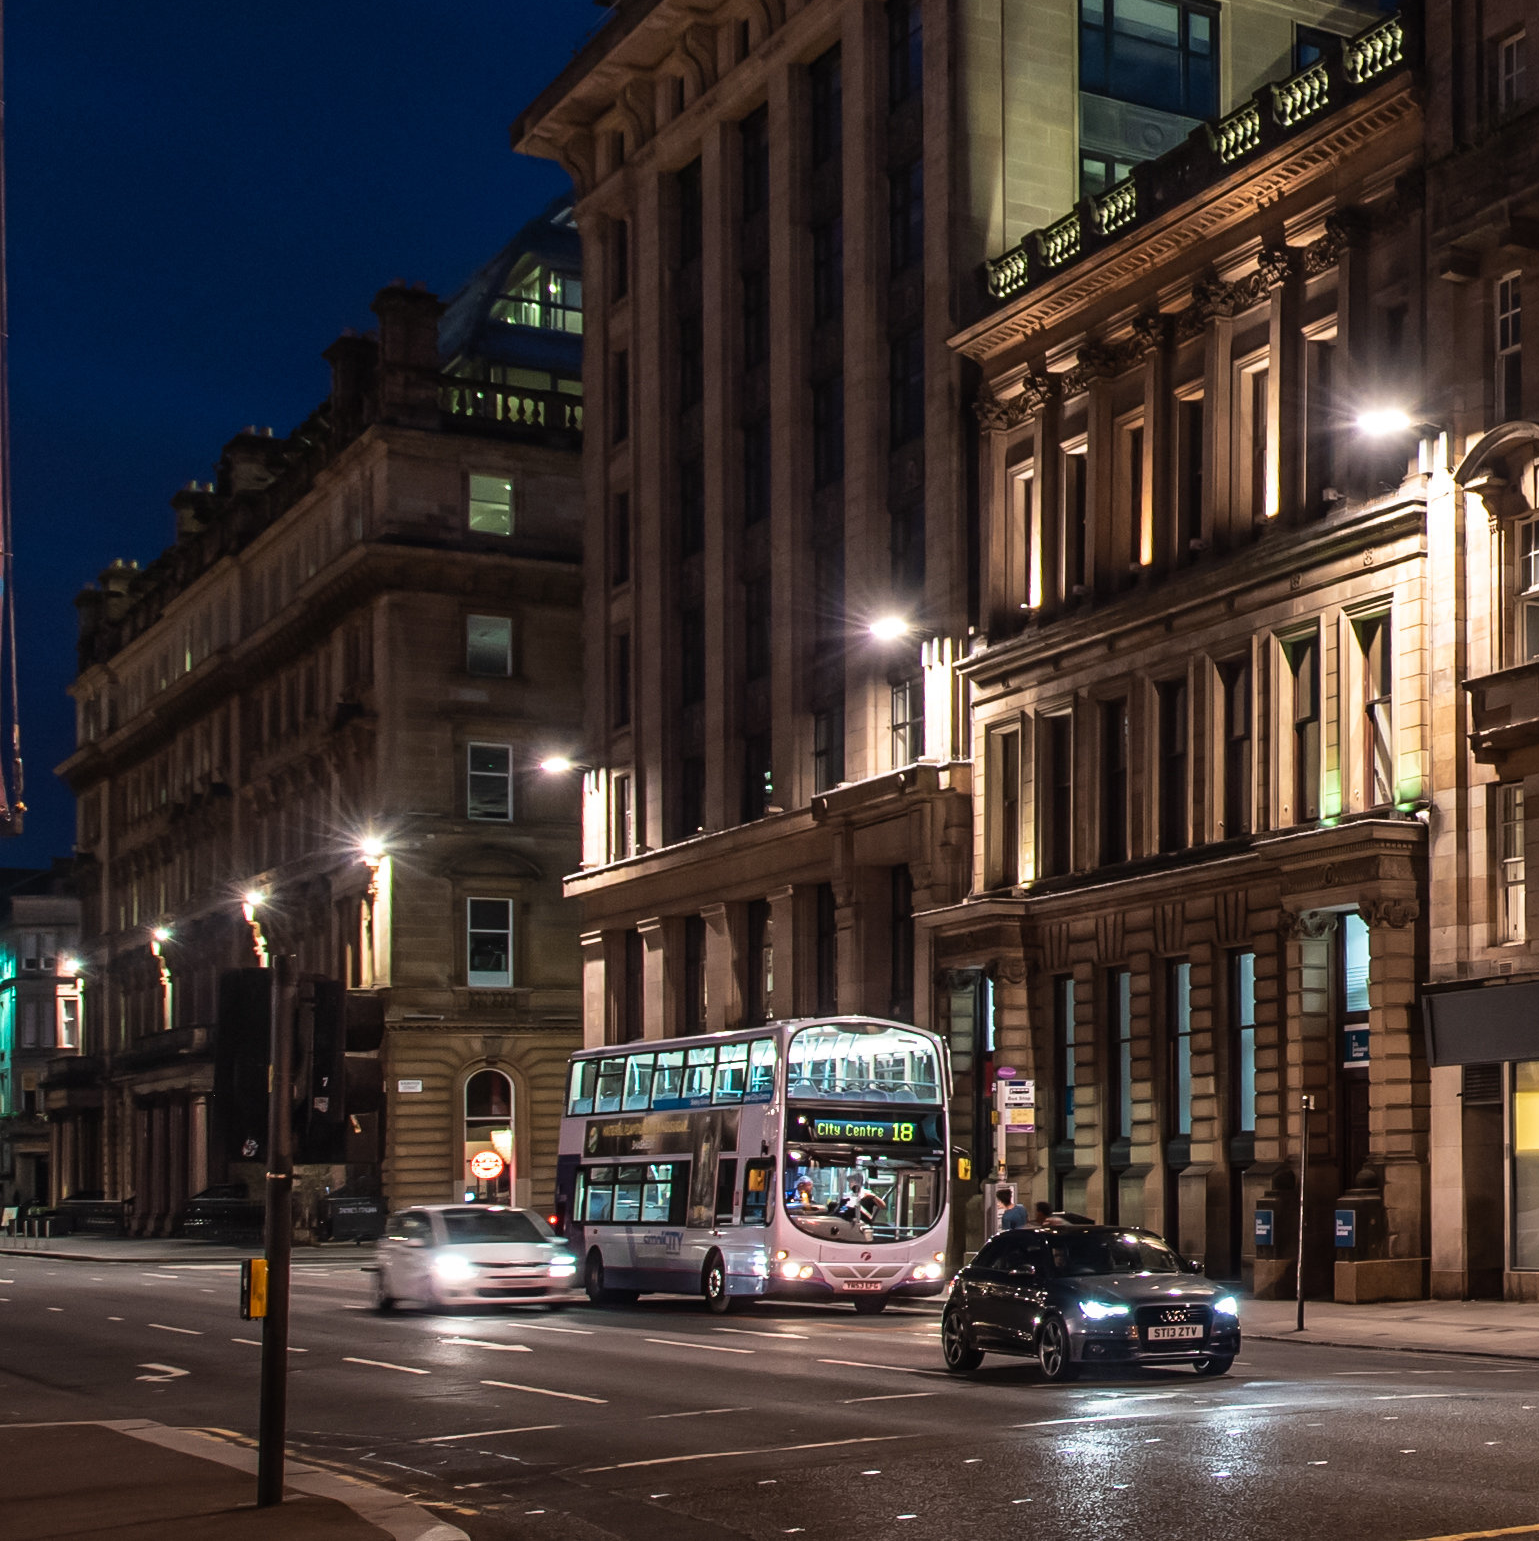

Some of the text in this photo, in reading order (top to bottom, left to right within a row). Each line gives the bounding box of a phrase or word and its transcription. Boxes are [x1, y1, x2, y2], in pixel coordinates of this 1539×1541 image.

[817, 1122, 914, 1142] City Centre 18
[1154, 1326, 1198, 1338] ST13 ZTV
